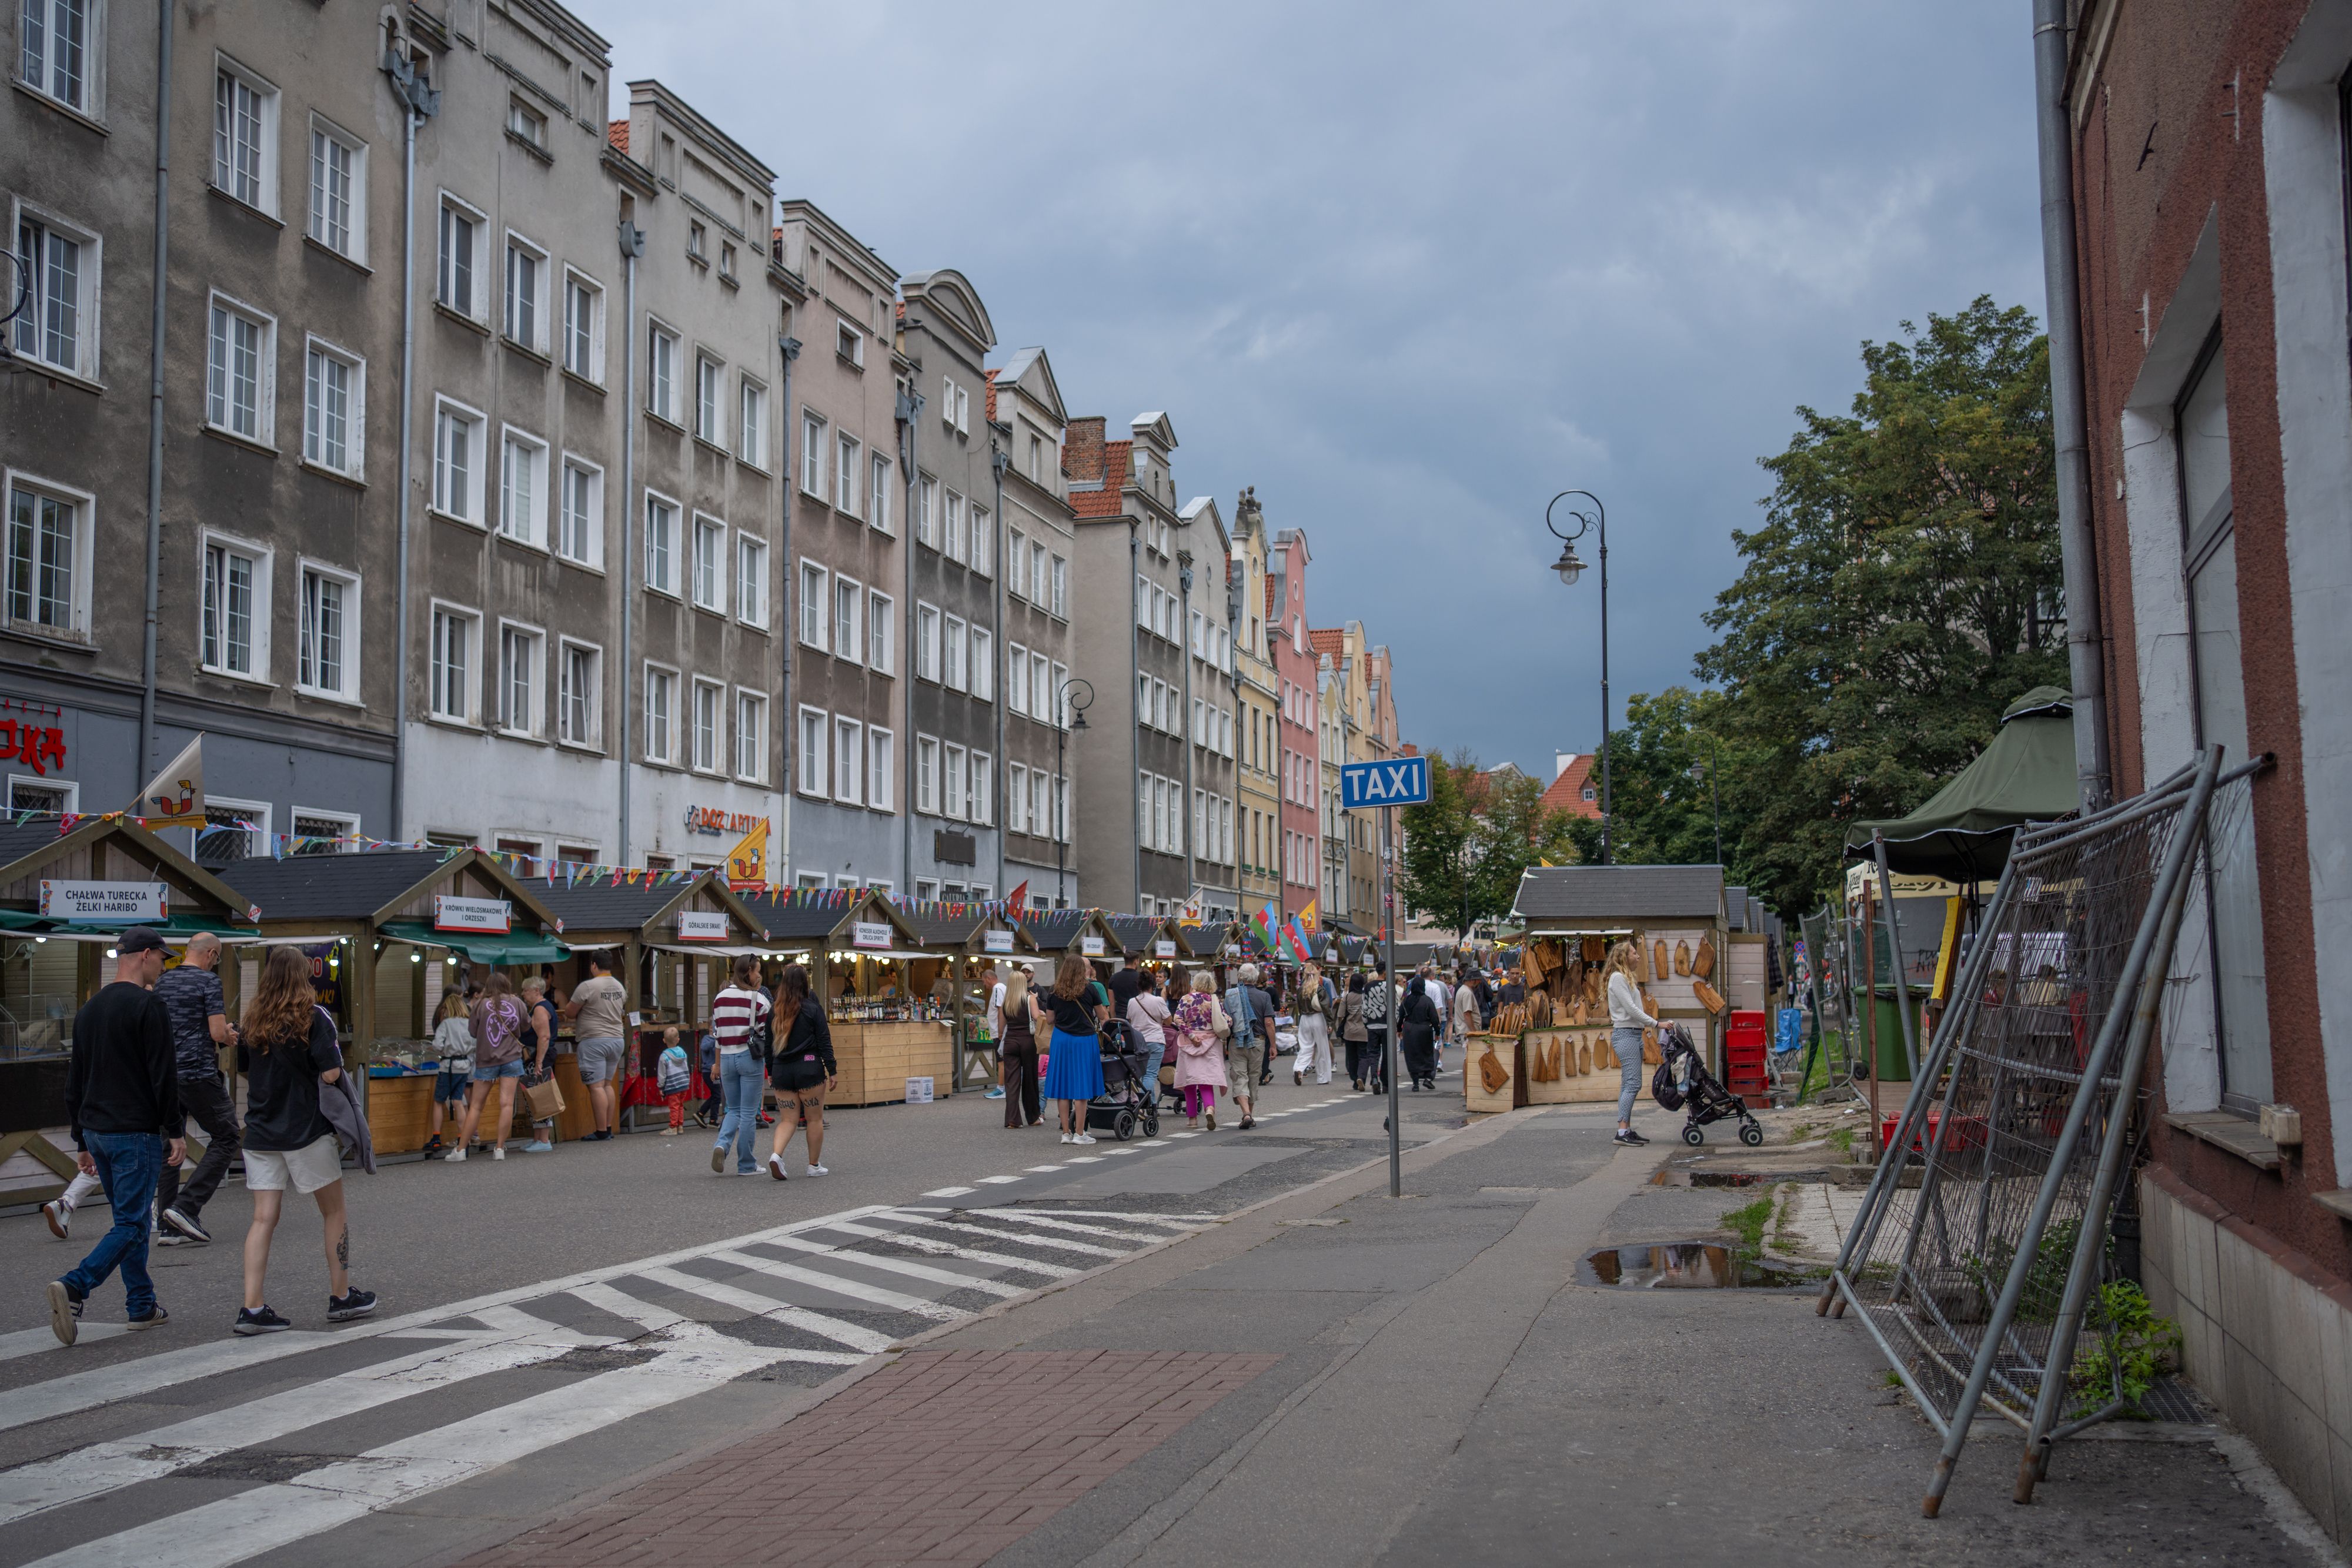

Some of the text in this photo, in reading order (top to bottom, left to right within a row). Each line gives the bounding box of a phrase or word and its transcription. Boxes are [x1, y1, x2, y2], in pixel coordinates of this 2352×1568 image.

[1345, 764, 1419, 801] TAXI
[701, 807, 725, 829] DOZ
[66, 890, 147, 900] CHAŁWA TURECKA
[76, 900, 137, 912] ŻELKI HARIBO
[466, 906, 502, 915] WIELOSMAKOWE
[689, 921, 709, 929] GÓRALSKIE
[600, 991, 623, 1001] NEW YORK
